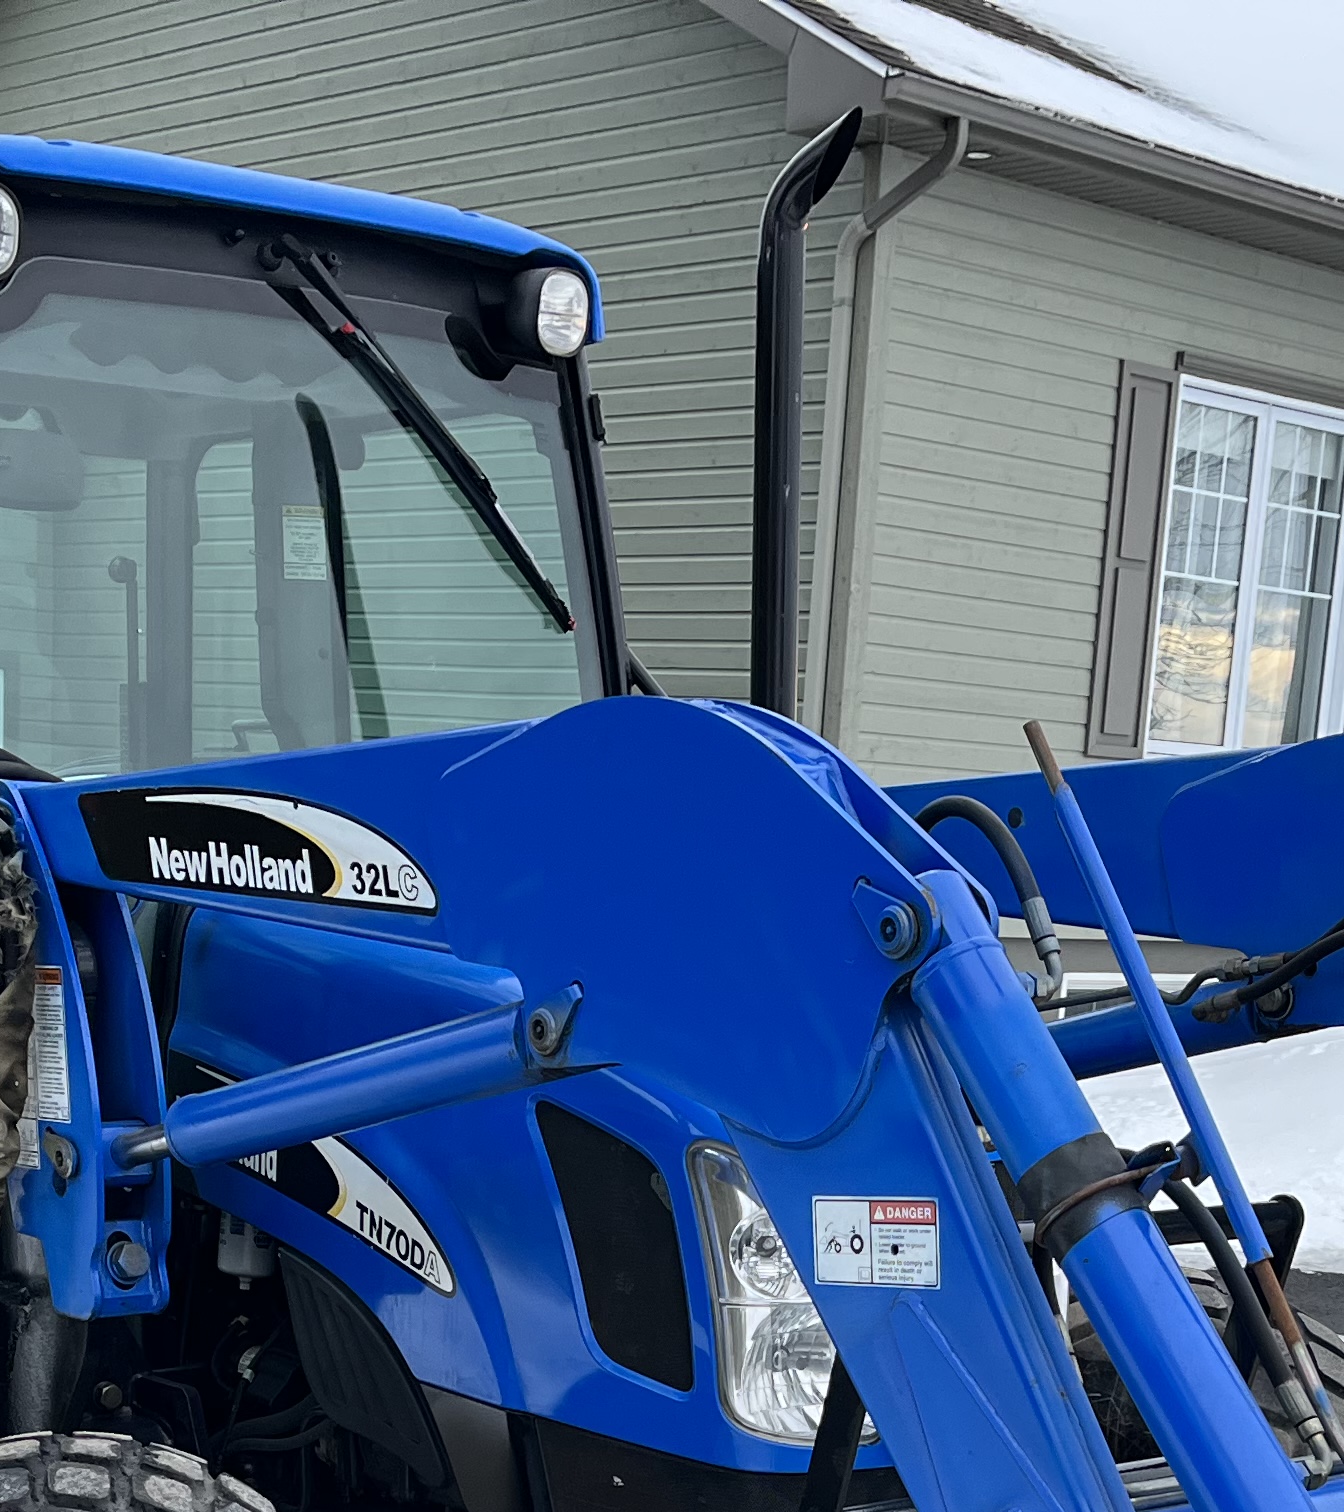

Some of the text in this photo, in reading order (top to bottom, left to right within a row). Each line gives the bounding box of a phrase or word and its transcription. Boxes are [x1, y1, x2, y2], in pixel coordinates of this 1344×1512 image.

[148, 836, 313, 894] New Holland
[349, 861, 419, 901] 32LC
[886, 1206, 932, 1219] DANGER
[355, 1199, 441, 1285] TN70DA
